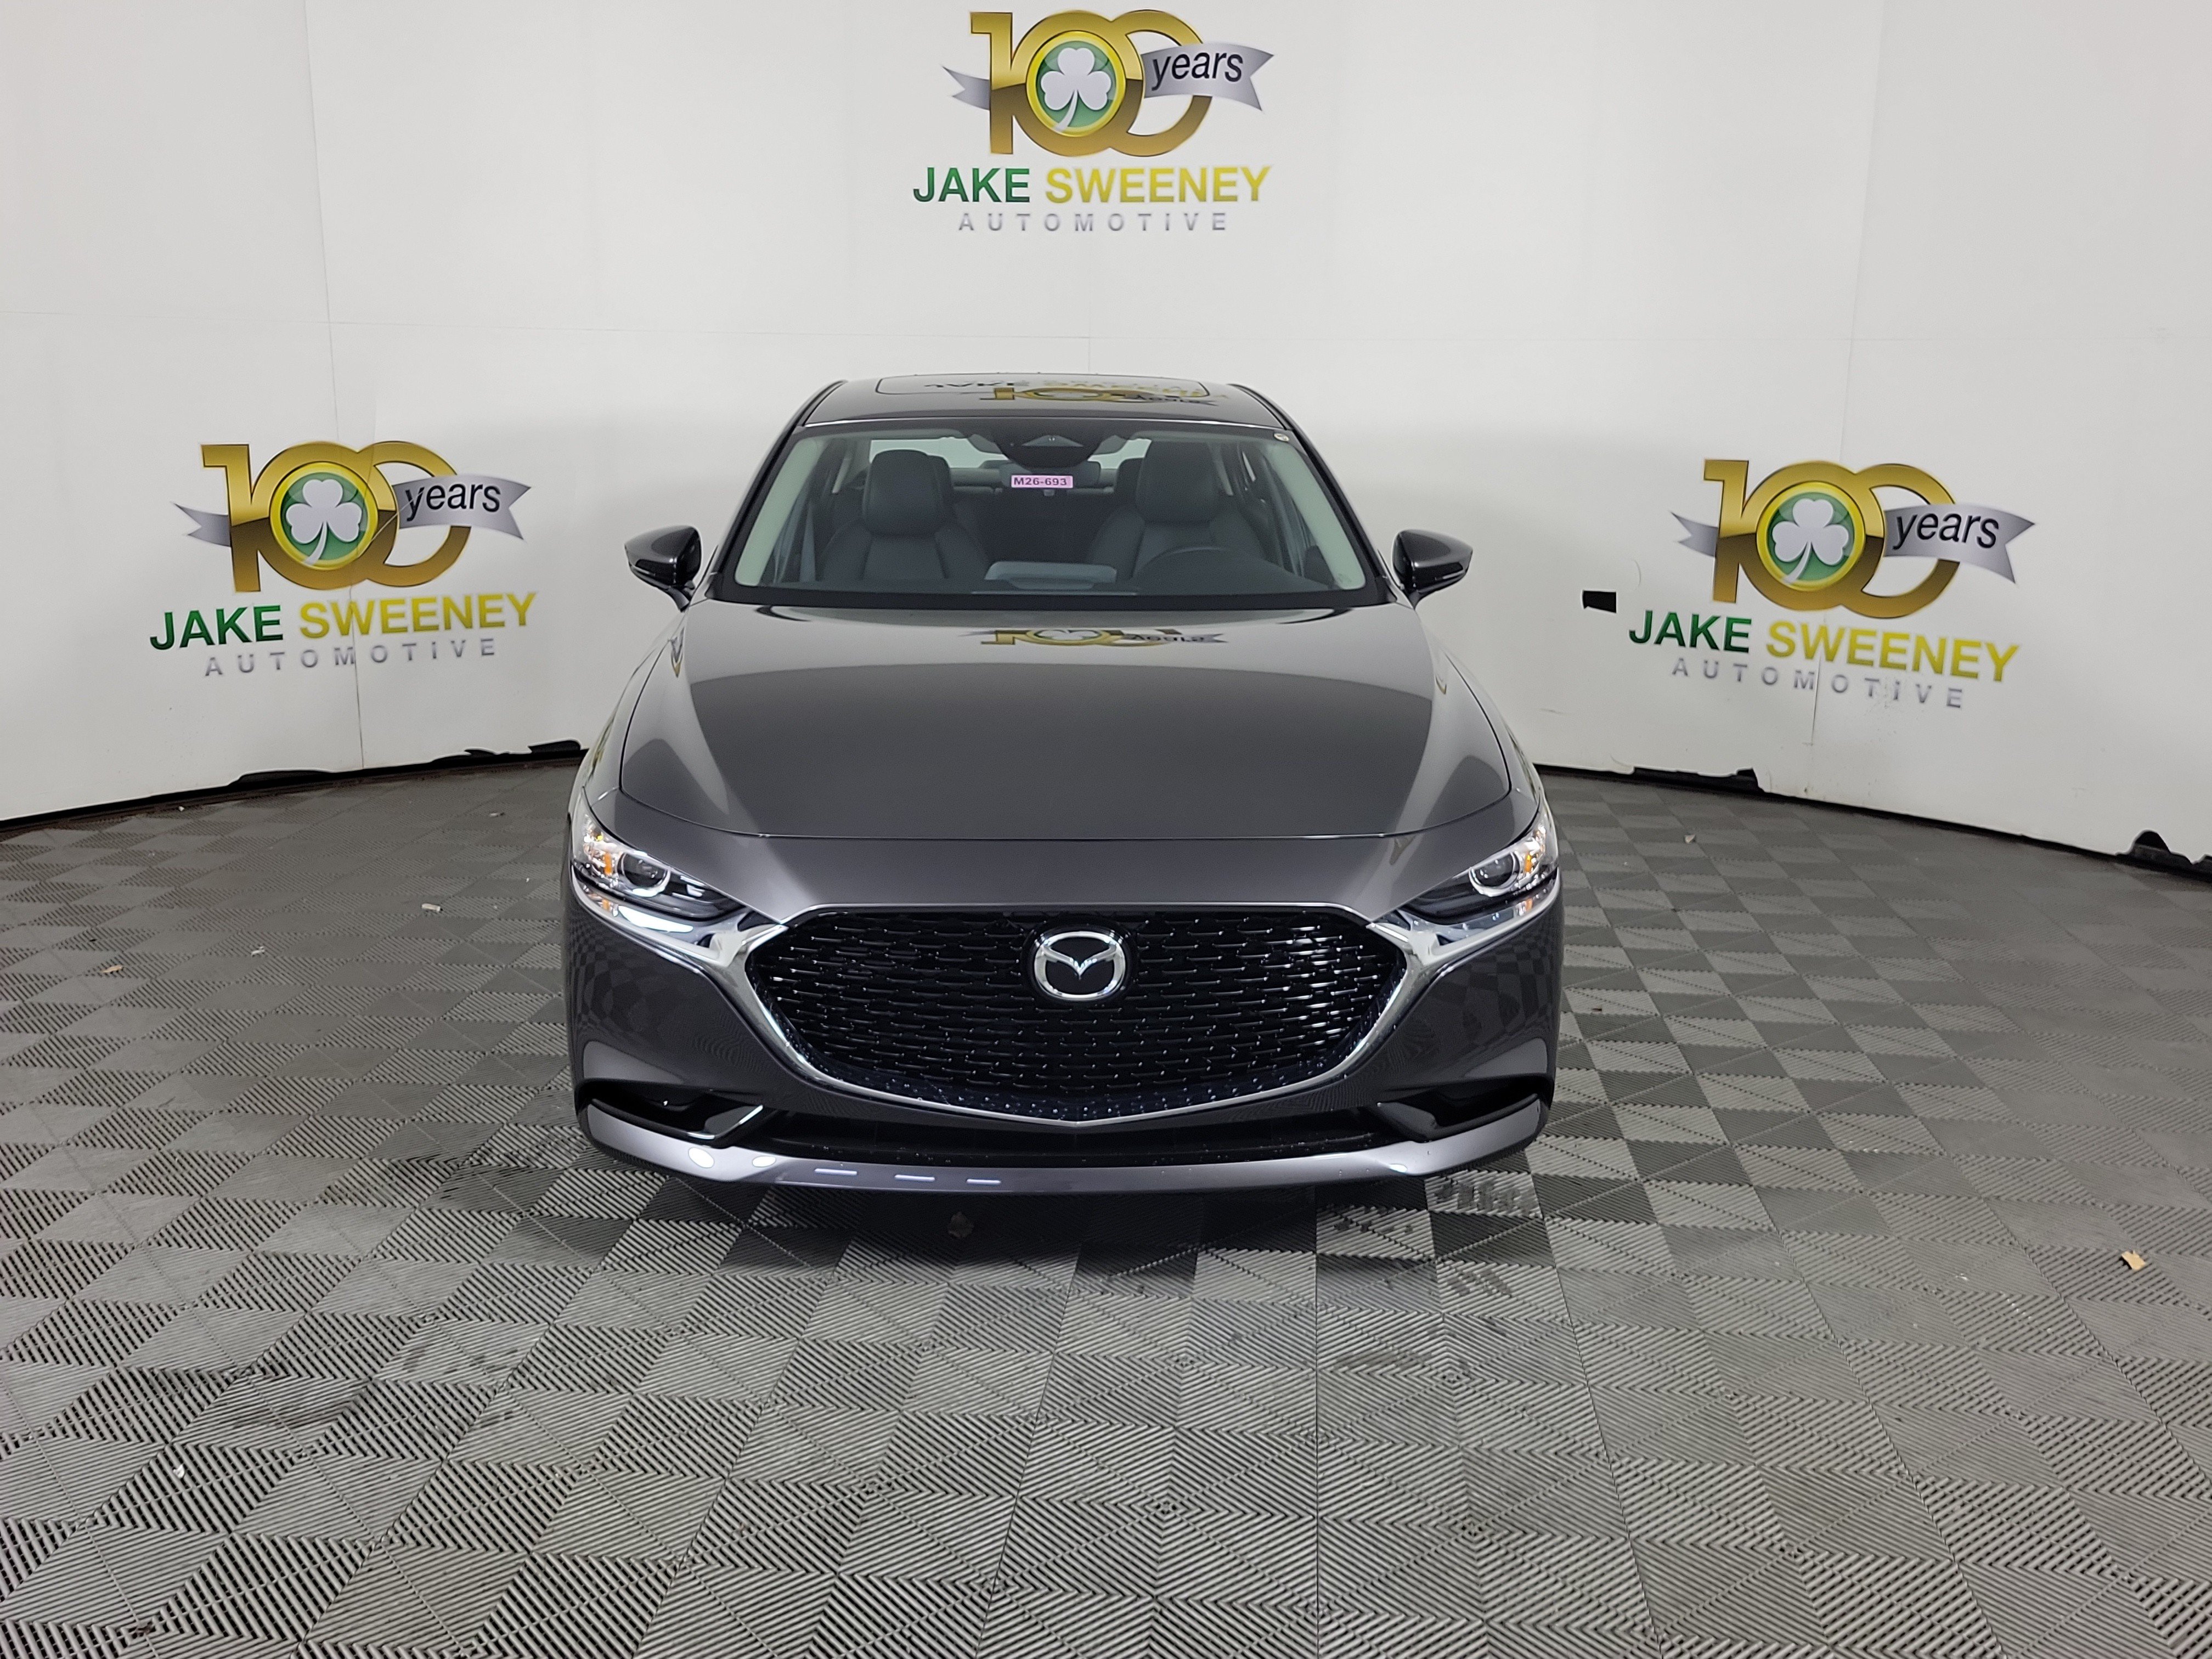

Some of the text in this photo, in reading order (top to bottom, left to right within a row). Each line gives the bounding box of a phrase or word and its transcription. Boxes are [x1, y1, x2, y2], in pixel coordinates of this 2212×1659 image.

[1152, 52, 1244, 91] years
[913, 166, 1271, 203] JAKE SWEENEY
[958, 212, 1227, 232] AUTOMOTIVE
[1014, 477, 1068, 486] M26-693
[405, 483, 501, 522] years
[1892, 510, 2000, 550] years
[149, 592, 538, 651] JAKE SWEENEY
[205, 637, 495, 676] AUTOMOTIVE
[1628, 610, 2020, 682] JAKE SWEENEY
[1671, 657, 1964, 709] AUTOMOTIVE
